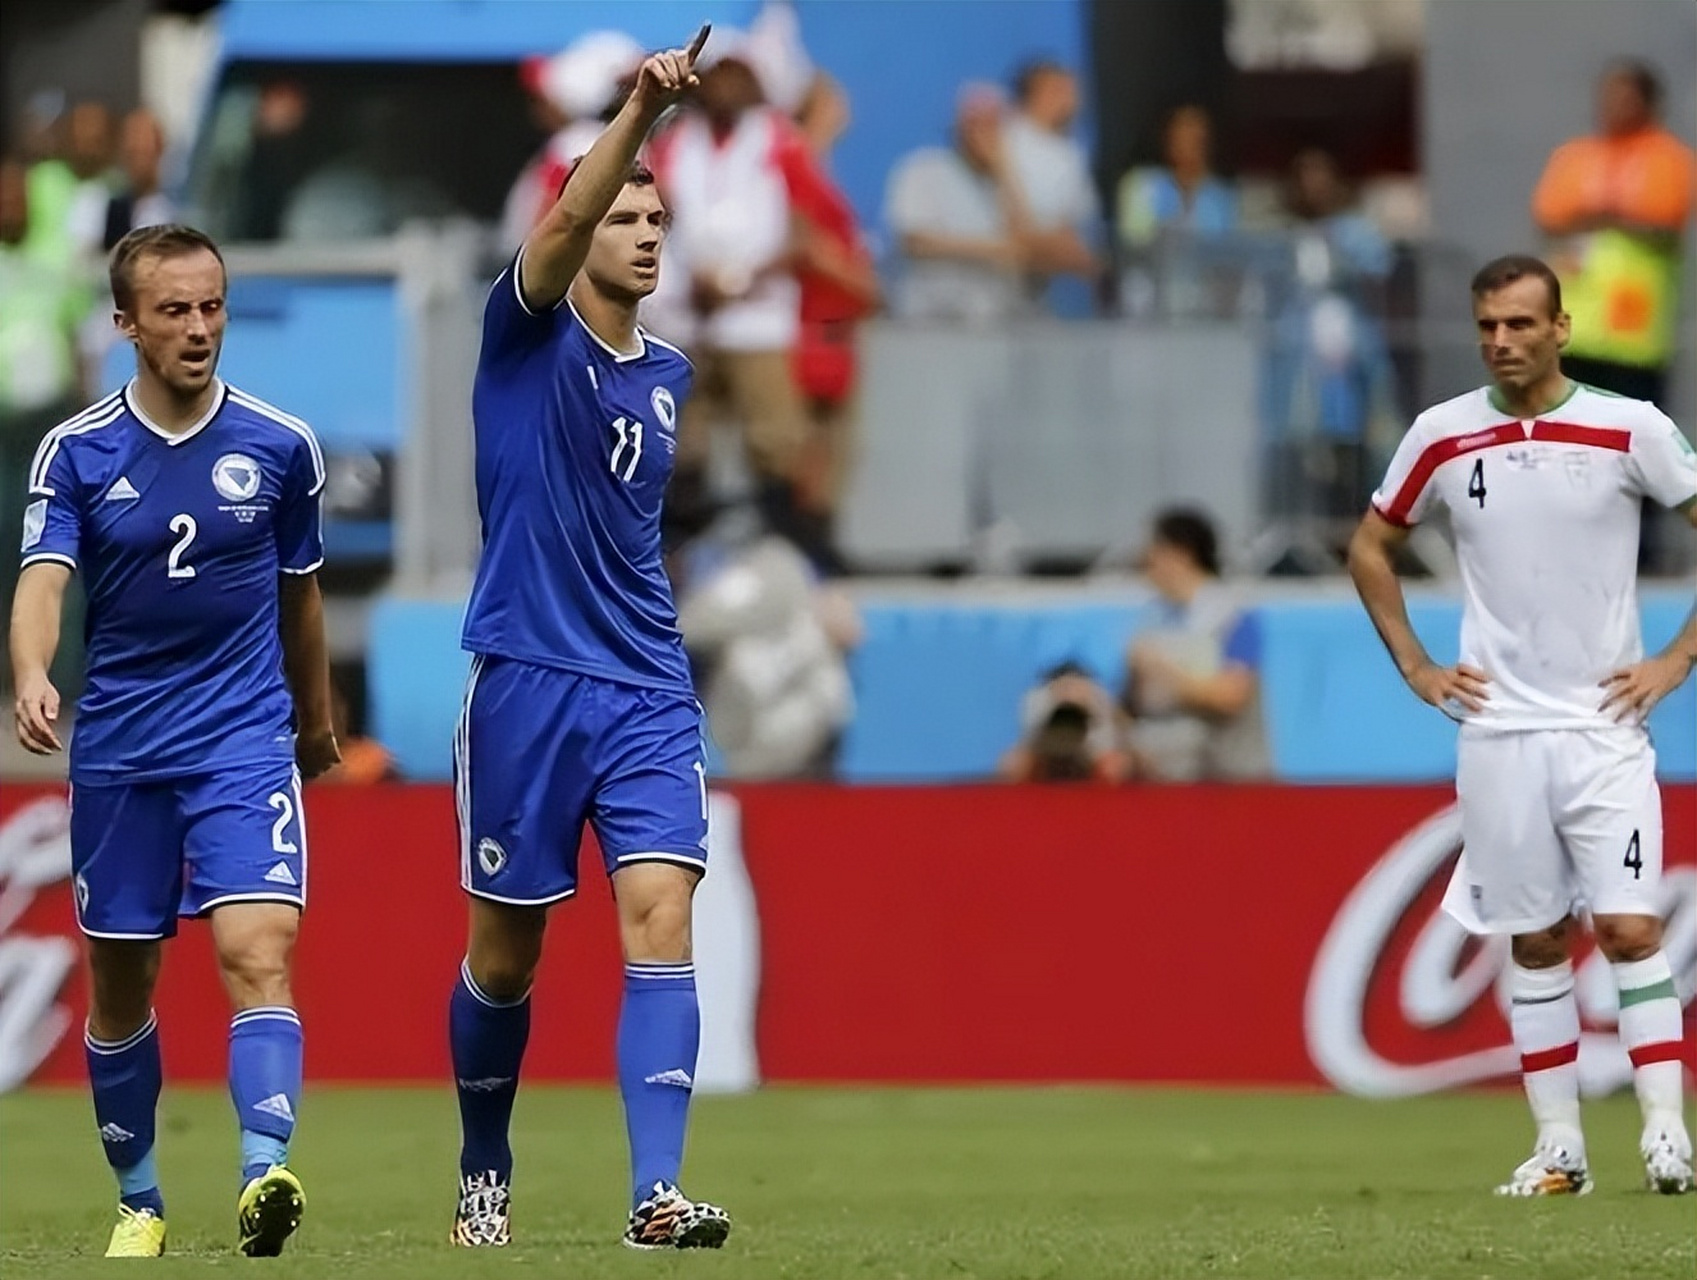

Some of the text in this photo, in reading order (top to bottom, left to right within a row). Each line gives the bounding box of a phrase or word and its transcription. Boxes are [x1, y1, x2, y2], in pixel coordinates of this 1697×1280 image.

[611, 416, 643, 483] 11
[1469, 458, 1487, 509] 4
[168, 513, 197, 578] 2
[268, 792, 297, 854] 2
[1624, 828, 1642, 880] 4
